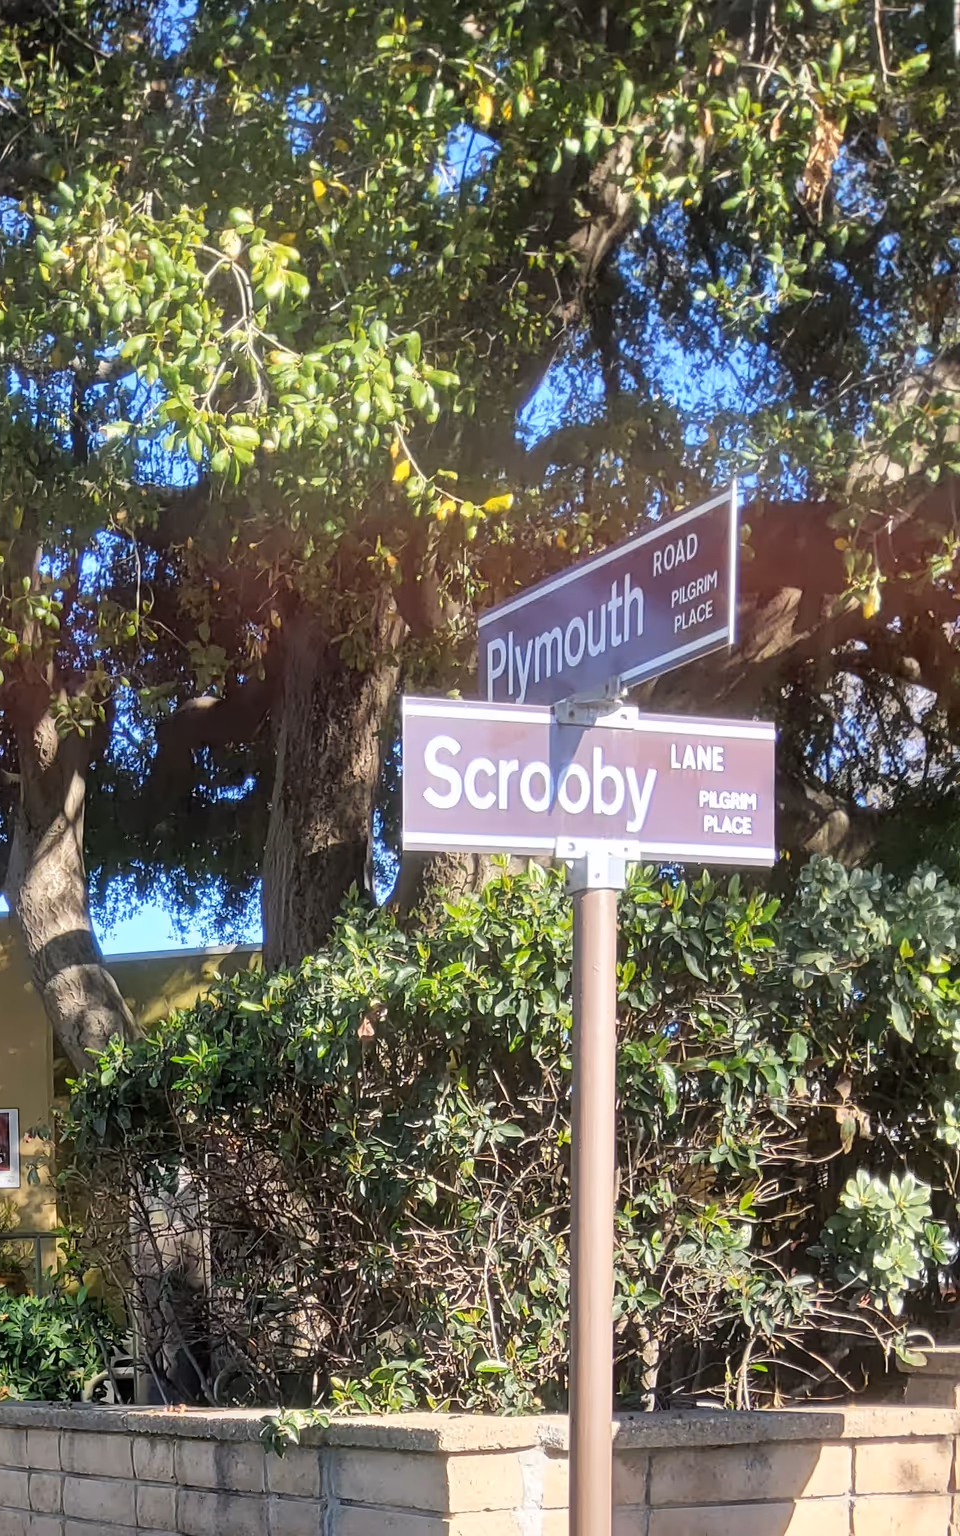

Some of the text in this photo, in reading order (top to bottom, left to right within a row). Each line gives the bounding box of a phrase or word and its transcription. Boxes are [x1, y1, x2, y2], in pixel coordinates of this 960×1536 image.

[671, 571, 718, 608] PILGRIM
[487, 533, 697, 704] Plymouth ROAD
[674, 601, 713, 633] PLACE
[422, 735, 724, 832] Scrooby LANE
[699, 791, 757, 811] PILGRIM
[704, 815, 752, 834] PLACE
